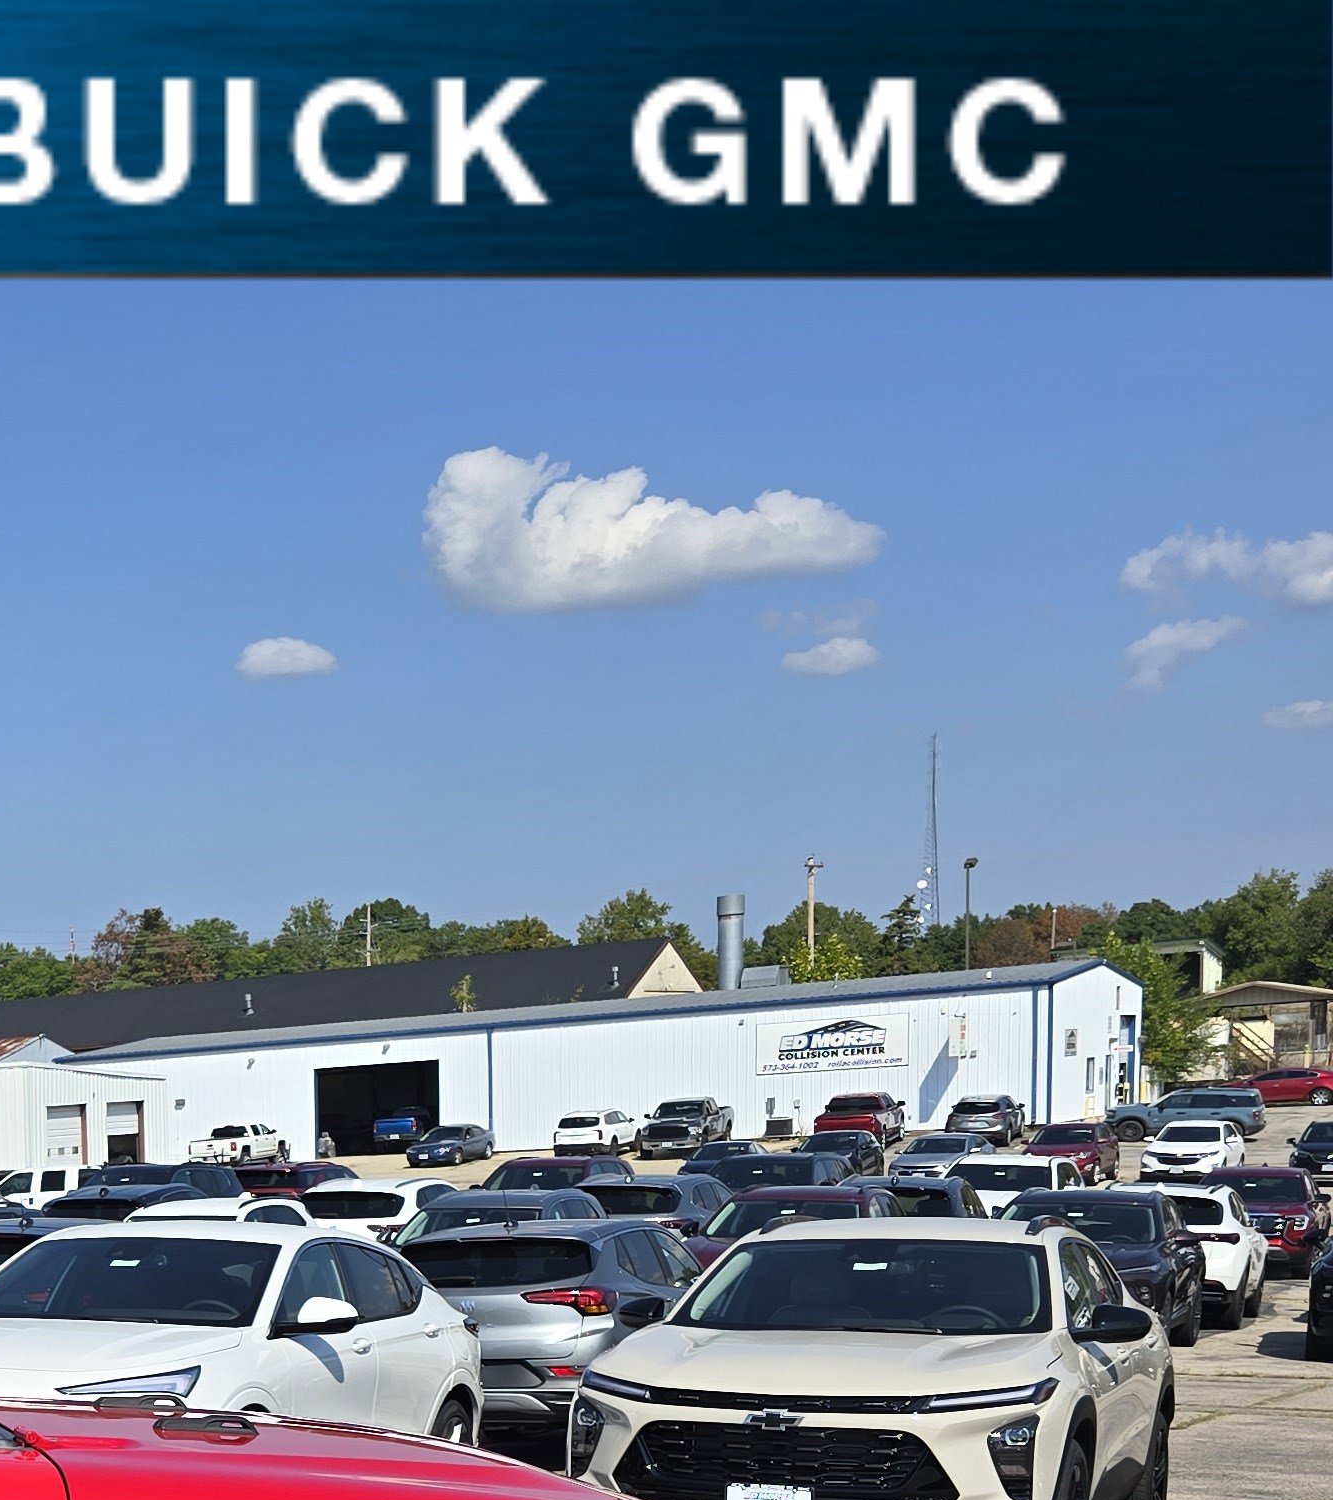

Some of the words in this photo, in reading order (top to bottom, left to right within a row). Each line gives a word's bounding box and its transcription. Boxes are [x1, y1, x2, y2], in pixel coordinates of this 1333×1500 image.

[779, 1035, 808, 1051] ED
[810, 1029, 886, 1050] MORSE
[778, 1049, 839, 1060] COLLISION
[842, 1046, 886, 1057] CENTER
